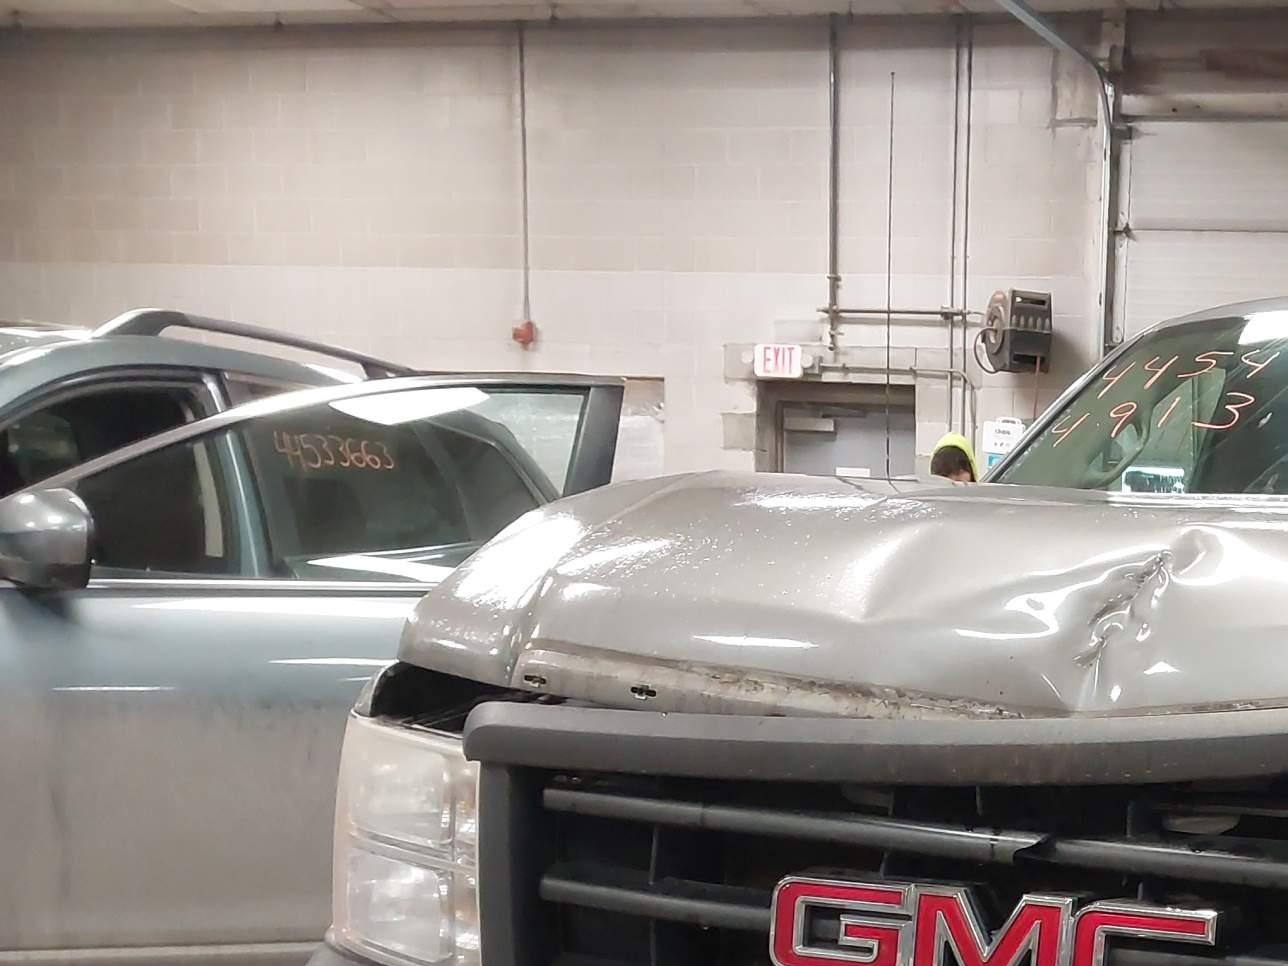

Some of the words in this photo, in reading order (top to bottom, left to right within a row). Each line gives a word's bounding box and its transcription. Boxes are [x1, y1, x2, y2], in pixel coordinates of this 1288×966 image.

[763, 346, 795, 375] EXIT
[1097, 349, 1281, 399] 4454
[1051, 392, 1256, 448] 4913
[273, 431, 395, 471] 44533663
